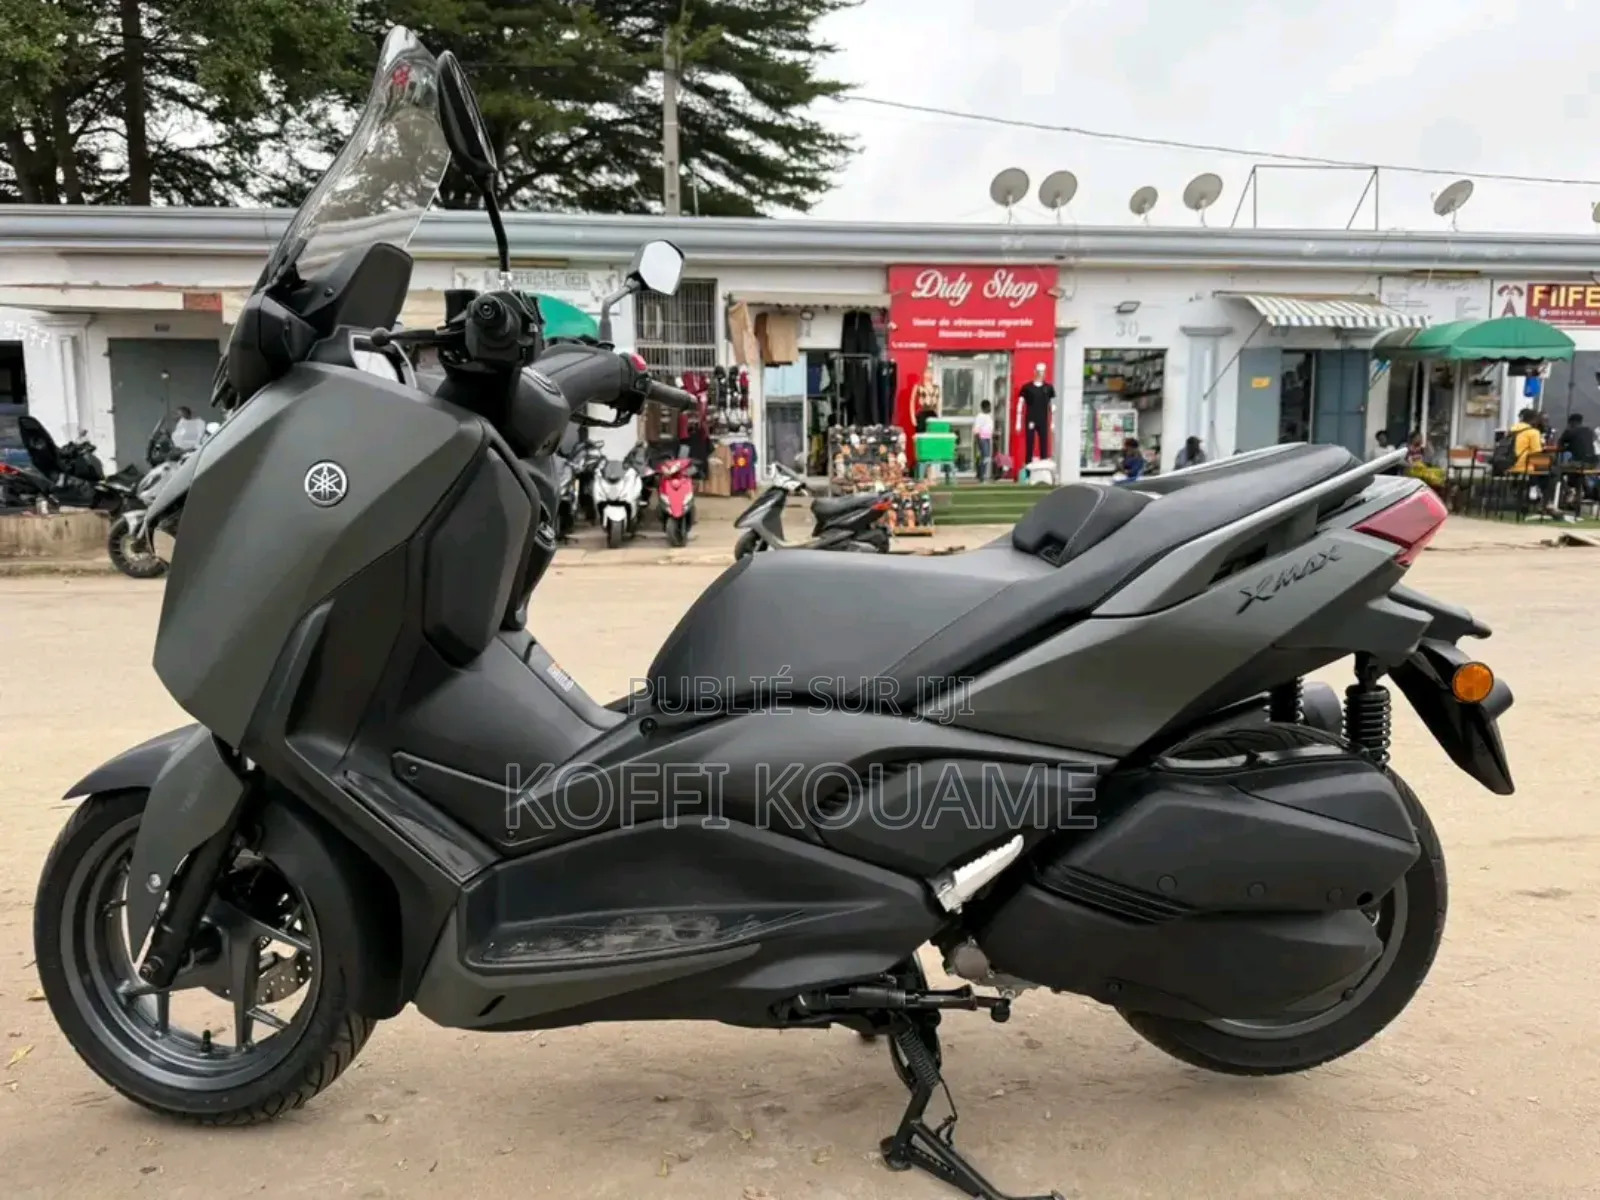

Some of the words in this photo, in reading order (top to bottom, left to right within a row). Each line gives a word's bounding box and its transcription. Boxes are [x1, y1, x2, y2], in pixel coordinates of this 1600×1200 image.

[911, 269, 973, 307] Didy
[983, 269, 1039, 308] Shop
[1115, 320, 1140, 338] 30
